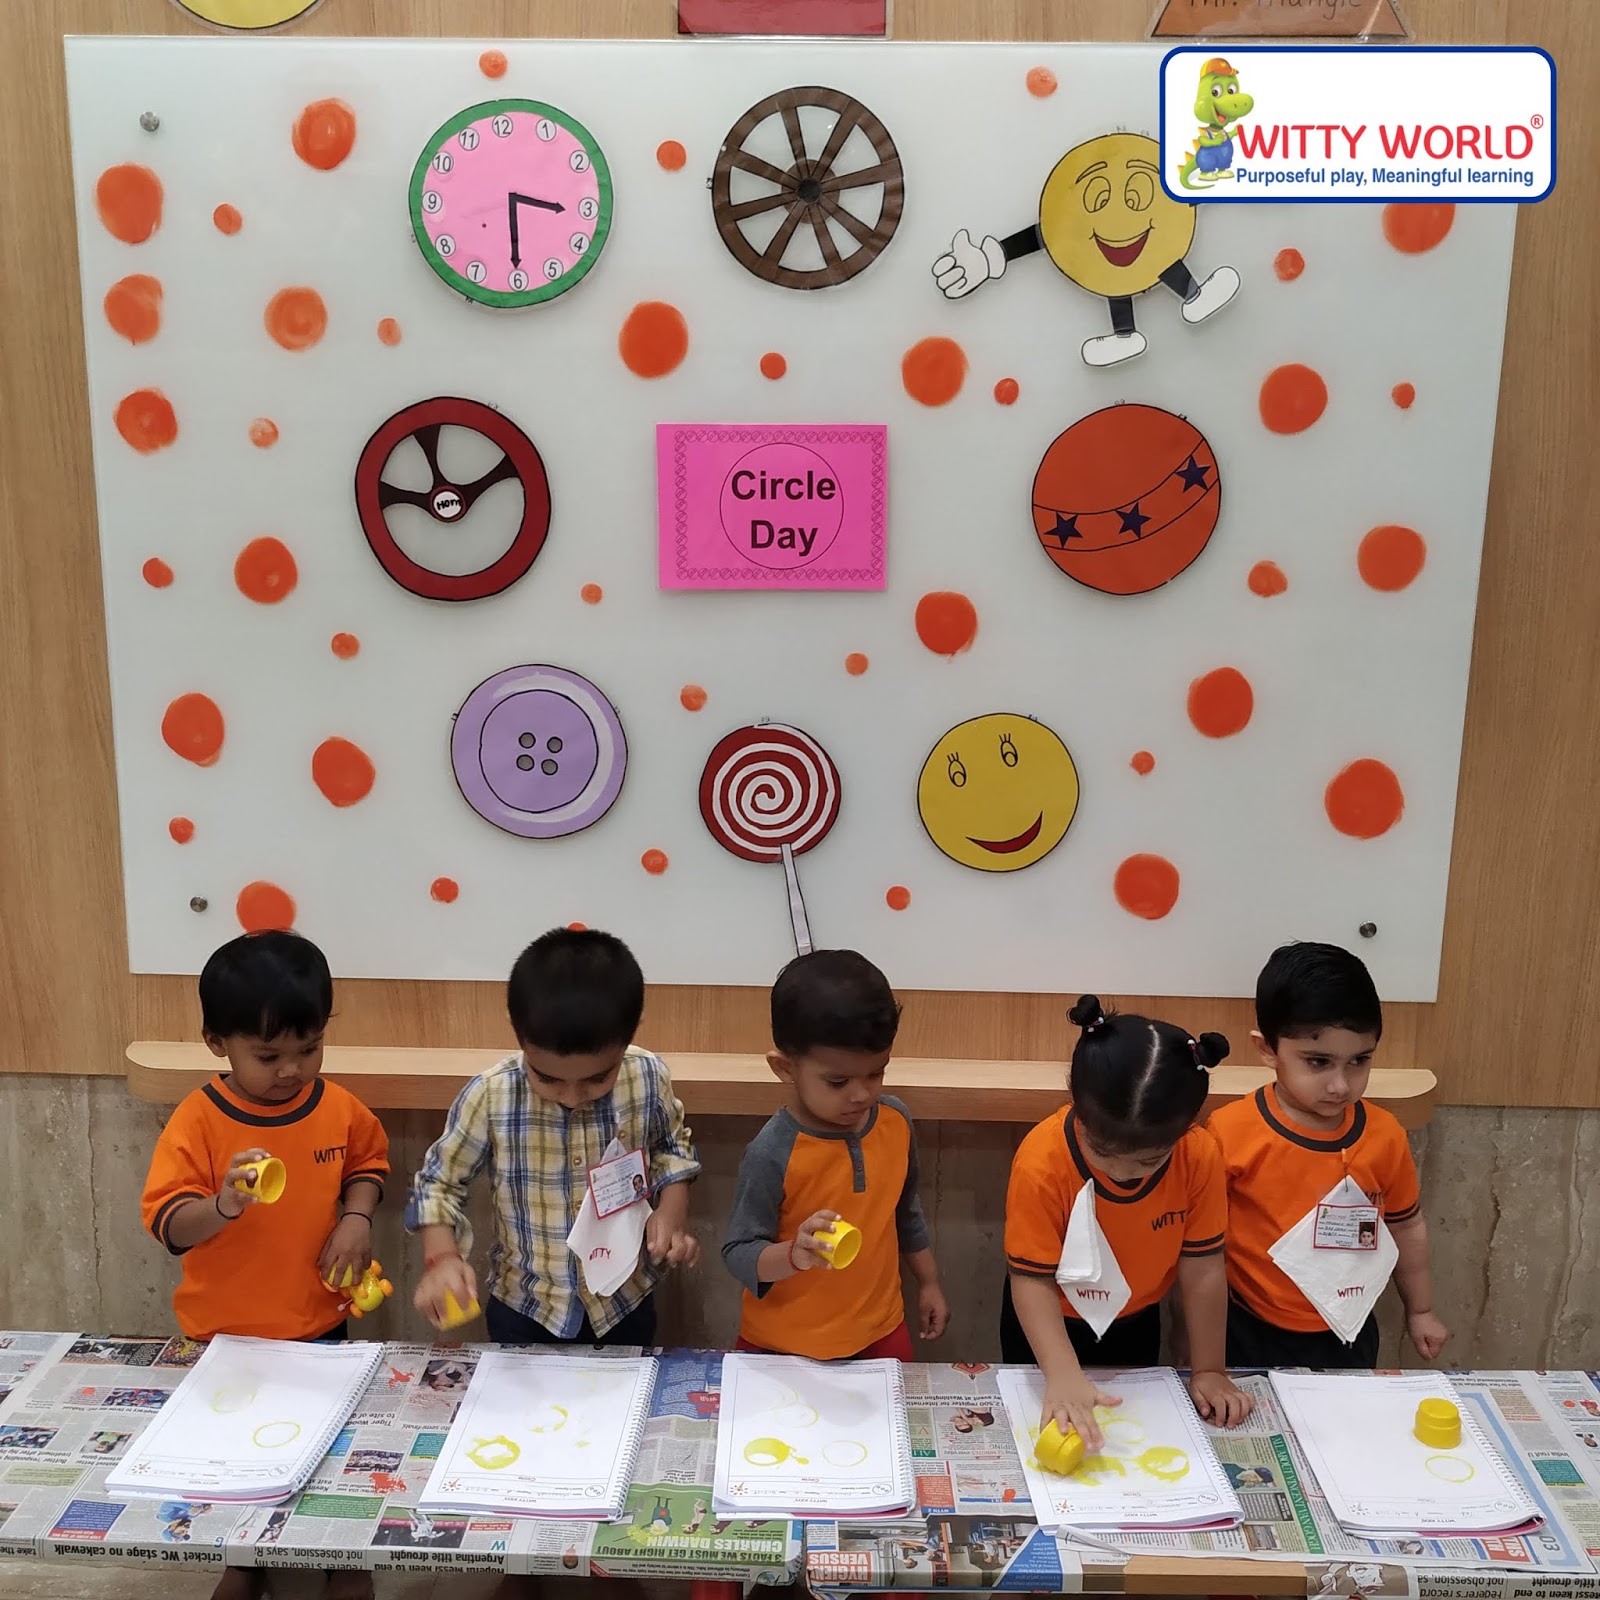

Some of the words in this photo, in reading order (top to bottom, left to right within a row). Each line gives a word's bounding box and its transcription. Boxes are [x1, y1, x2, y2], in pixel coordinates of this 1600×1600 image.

[493, 120, 512, 136] 12
[542, 122, 550, 140] 1
[460, 131, 476, 149] 11
[434, 154, 452, 173] 10
[574, 153, 585, 171] 2
[427, 193, 438, 210] 9
[583, 201, 593, 218] 3
[440, 238, 452, 255] 8
[573, 236, 584, 252] 4
[470, 264, 481, 281] 7
[548, 261, 558, 279] 5
[513, 272, 523, 289] 6
[731, 469, 837, 501] Circle
[750, 519, 819, 557] Day
[313, 1145, 348, 1164] WITT
[1151, 1210, 1187, 1232] WITT
[1076, 1287, 1112, 1302] WITTY
[1337, 1285, 1366, 1298] WITTY
[950, 1400, 978, 1408] register
[370, 1419, 392, 1427] Tiger
[1279, 1450, 1292, 1475] ABOUT
[1288, 1475, 1303, 1506] VINCENT
[1299, 1507, 1310, 1523] VAN
[1305, 1527, 1320, 1550] GOGH
[646, 1535, 711, 1549] DARWIN
[713, 1538, 784, 1553] CHARLES
[1539, 1535, 1560, 1552] 03
[17, 1546, 38, 1557] take
[54, 1544, 106, 1558] cakewalk
[109, 1547, 123, 1558] no
[127, 1546, 158, 1560] stage
[161, 1550, 180, 1562] WC
[183, 1550, 224, 1564] cricket
[265, 1546, 289, 1558] says
[291, 1547, 345, 1560] obsession,
[346, 1550, 364, 1561] not
[389, 1549, 429, 1563] drought
[431, 1552, 452, 1563] title
[455, 1551, 505, 1565] Argentina
[596, 1546, 631, 1558] ABOUT
[632, 1547, 665, 1559] RIGHT
[667, 1548, 687, 1560] GET
[688, 1549, 719, 1561] MUST
[719, 1550, 739, 1561] WE
[740, 1551, 773, 1563] FACTS
[808, 1553, 869, 1566] VERSUS
[1431, 1574, 1482, 1587] obsession,
[1483, 1576, 1504, 1587] not
[1531, 1575, 1572, 1587] drought
[1574, 1578, 1595, 1588] title
[1420, 1588, 1453, 1599] record
[1514, 1589, 1533, 1598] end
[1535, 1591, 1547, 1599] to
[1549, 1590, 1573, 1599] keen
